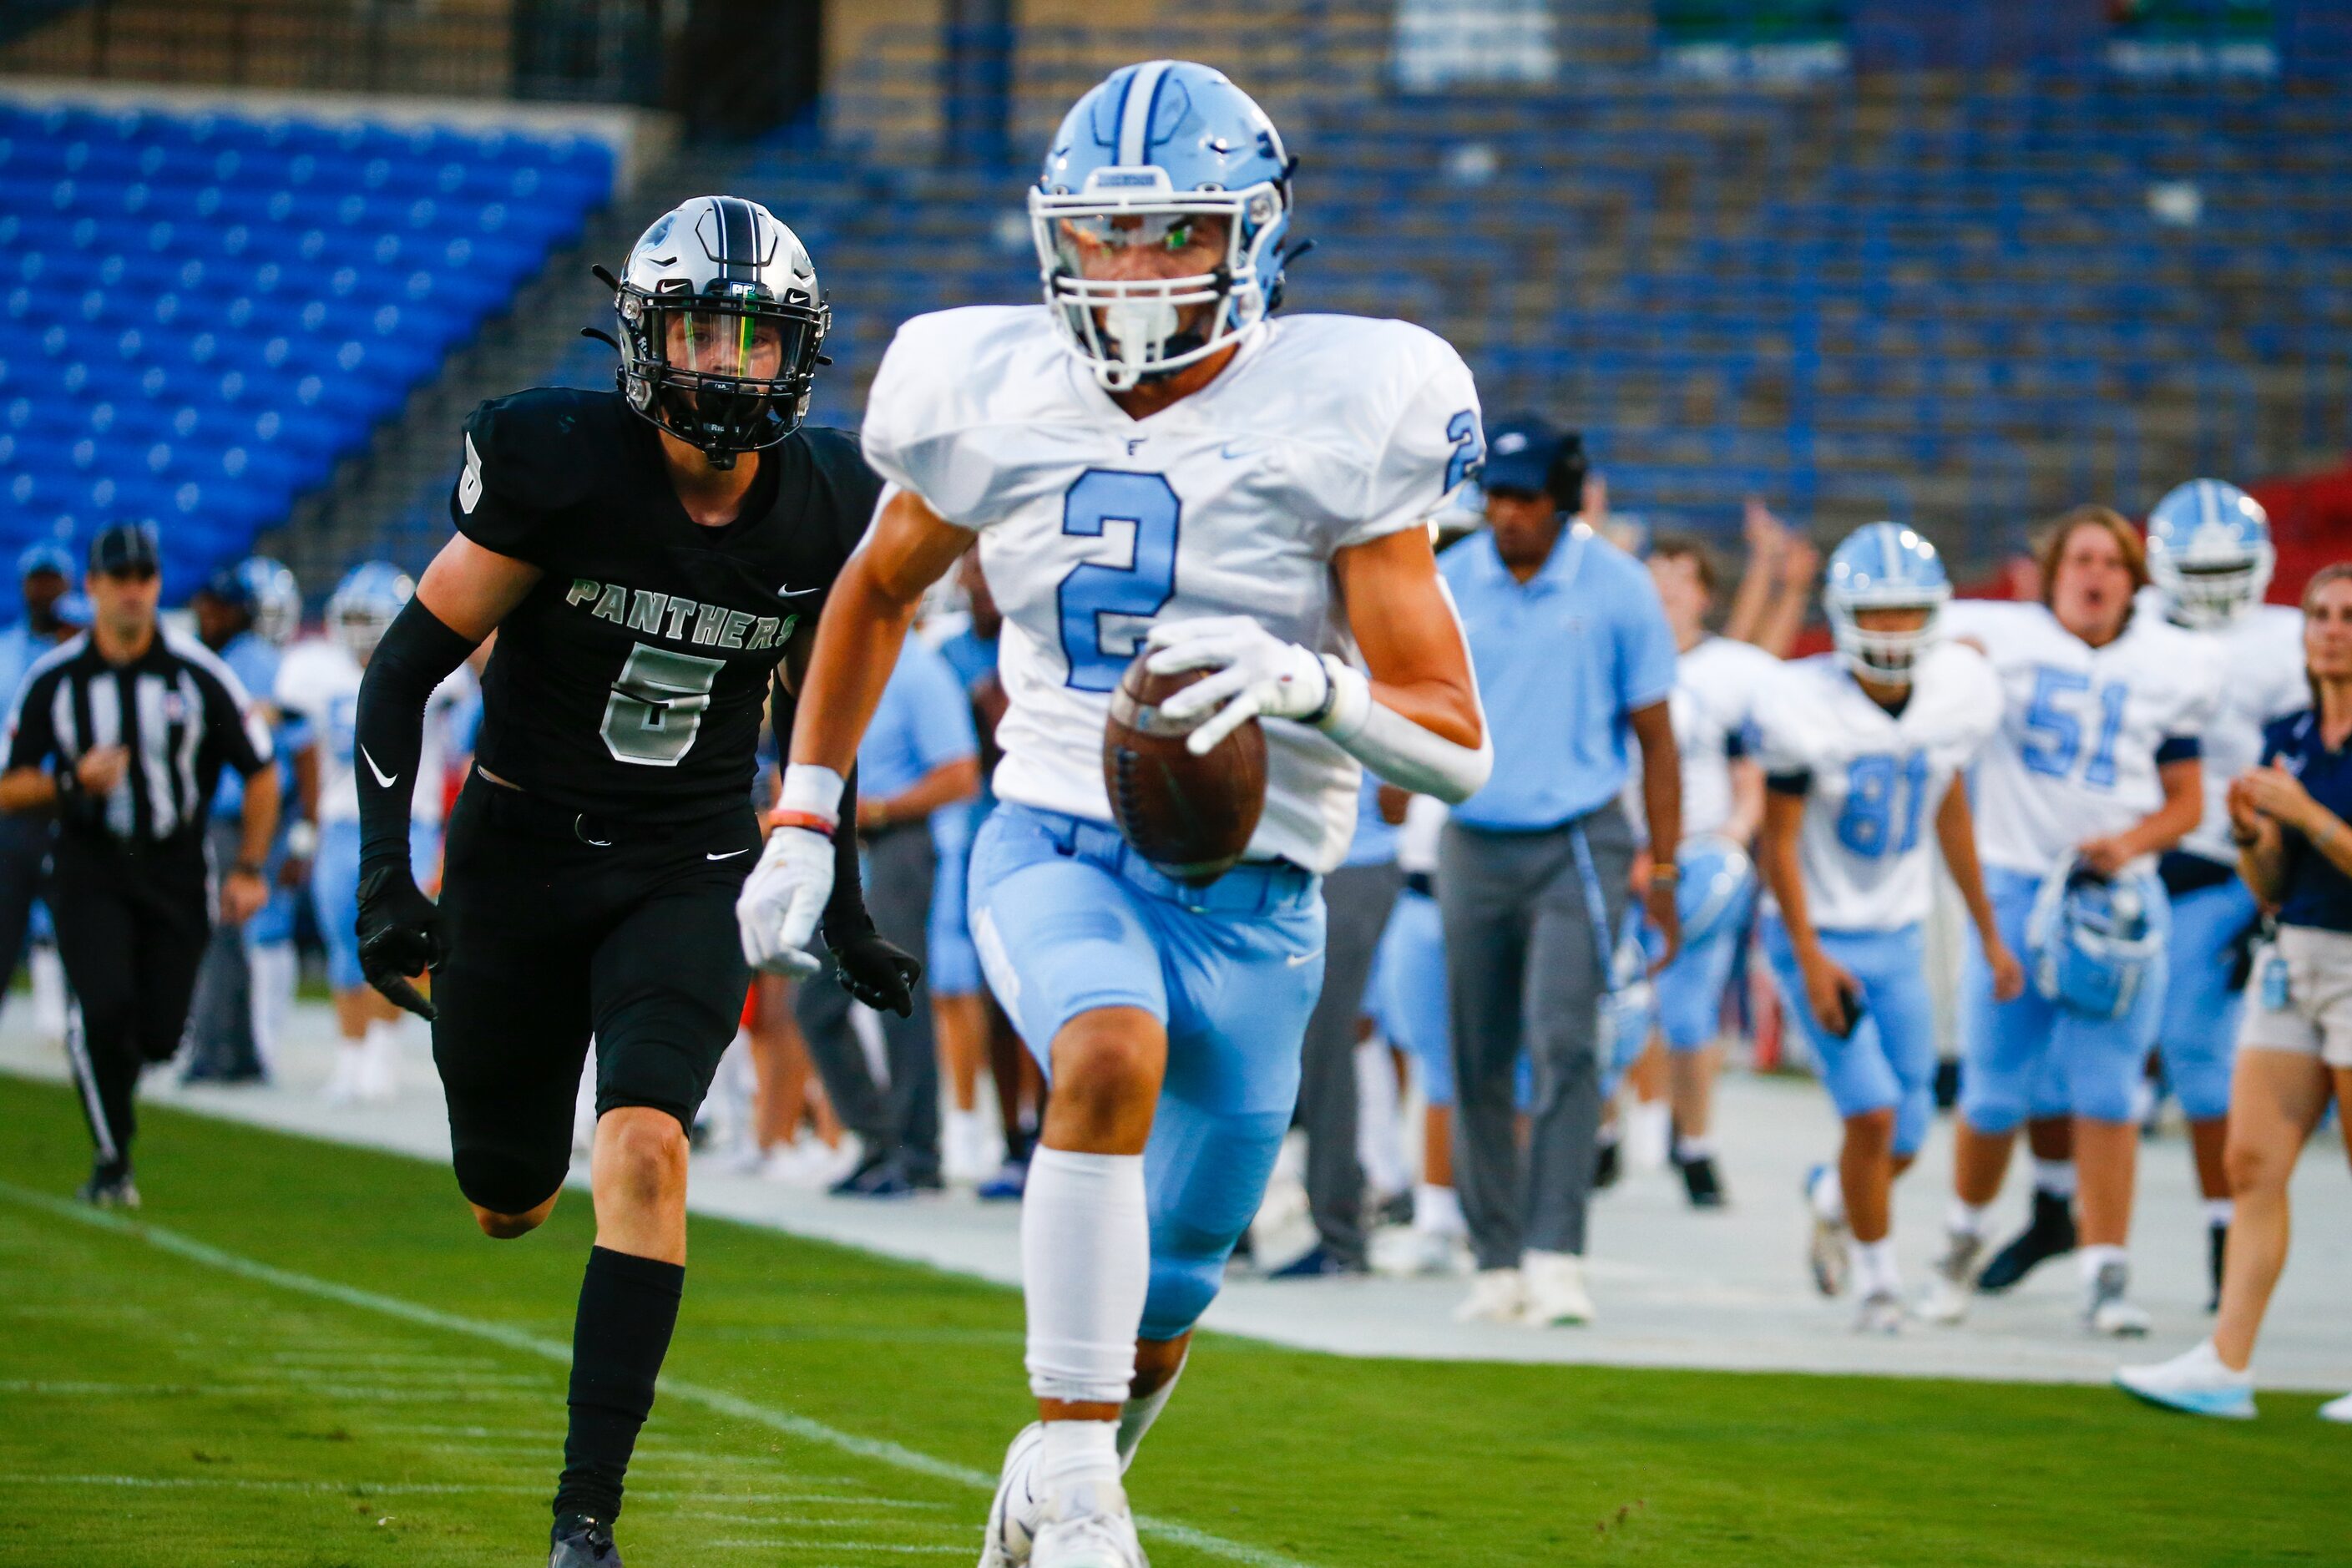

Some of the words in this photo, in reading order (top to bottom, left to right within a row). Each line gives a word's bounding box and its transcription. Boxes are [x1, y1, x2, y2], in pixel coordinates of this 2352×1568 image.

[1443, 408, 1482, 496] 2
[565, 579, 801, 650] PANTHERS
[1057, 468, 1182, 693] 2
[2020, 665, 2128, 787] 51
[1837, 747, 1930, 858] 81
